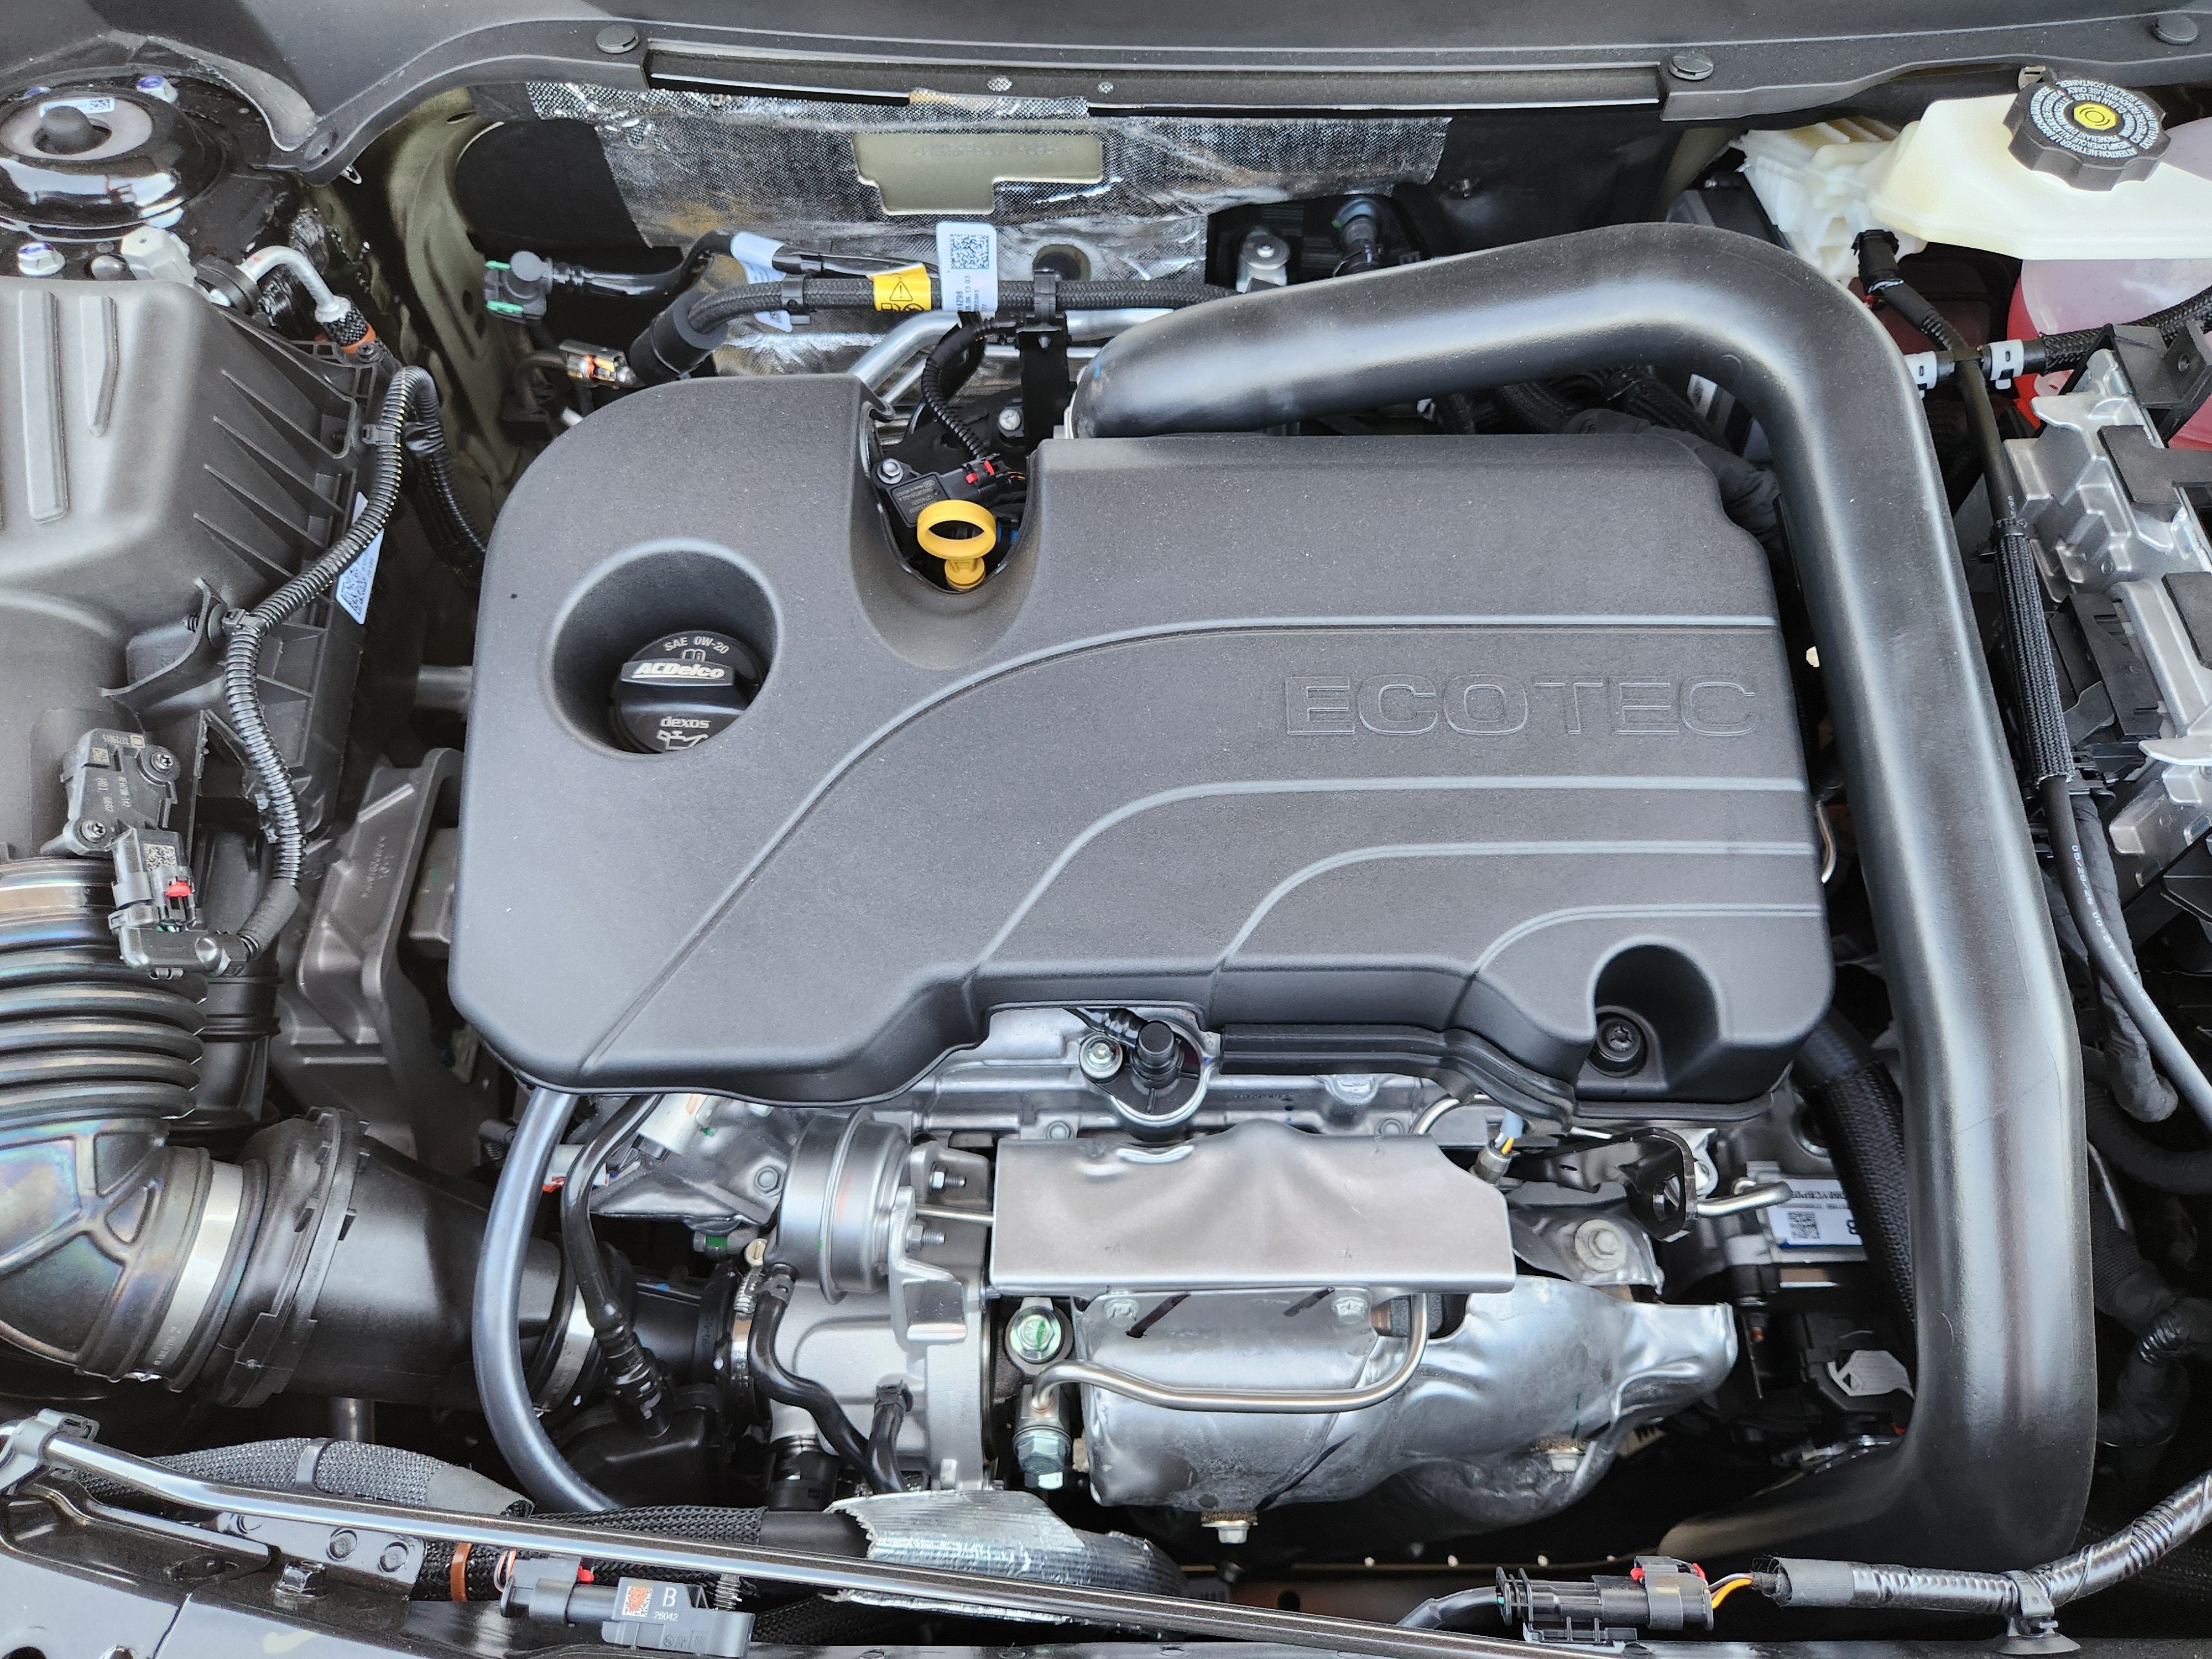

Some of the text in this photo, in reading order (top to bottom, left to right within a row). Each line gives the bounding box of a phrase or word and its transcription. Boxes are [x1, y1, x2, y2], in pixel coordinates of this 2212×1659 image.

[2067, 86, 2087, 95] ONLY
[2072, 93, 2101, 102] FILLER
[2088, 87, 2105, 96] USE
[2107, 85, 2138, 102] SEALED
[2101, 97, 2127, 113] CLEAN
[2138, 104, 2157, 121] FROM
[2133, 113, 2147, 134] BEFORE
[2148, 121, 2159, 137] FLUID
[2069, 137, 2087, 146] QUE
[2130, 132, 2144, 143] CAP
[665, 636, 729, 654] SAE 0W-20
[634, 662, 725, 679] ACDelco
[1285, 675, 1756, 736] ECOTEC
[661, 716, 711, 729] dexos
[663, 1587, 677, 1607] B
[654, 1611, 679, 1621] 26042
